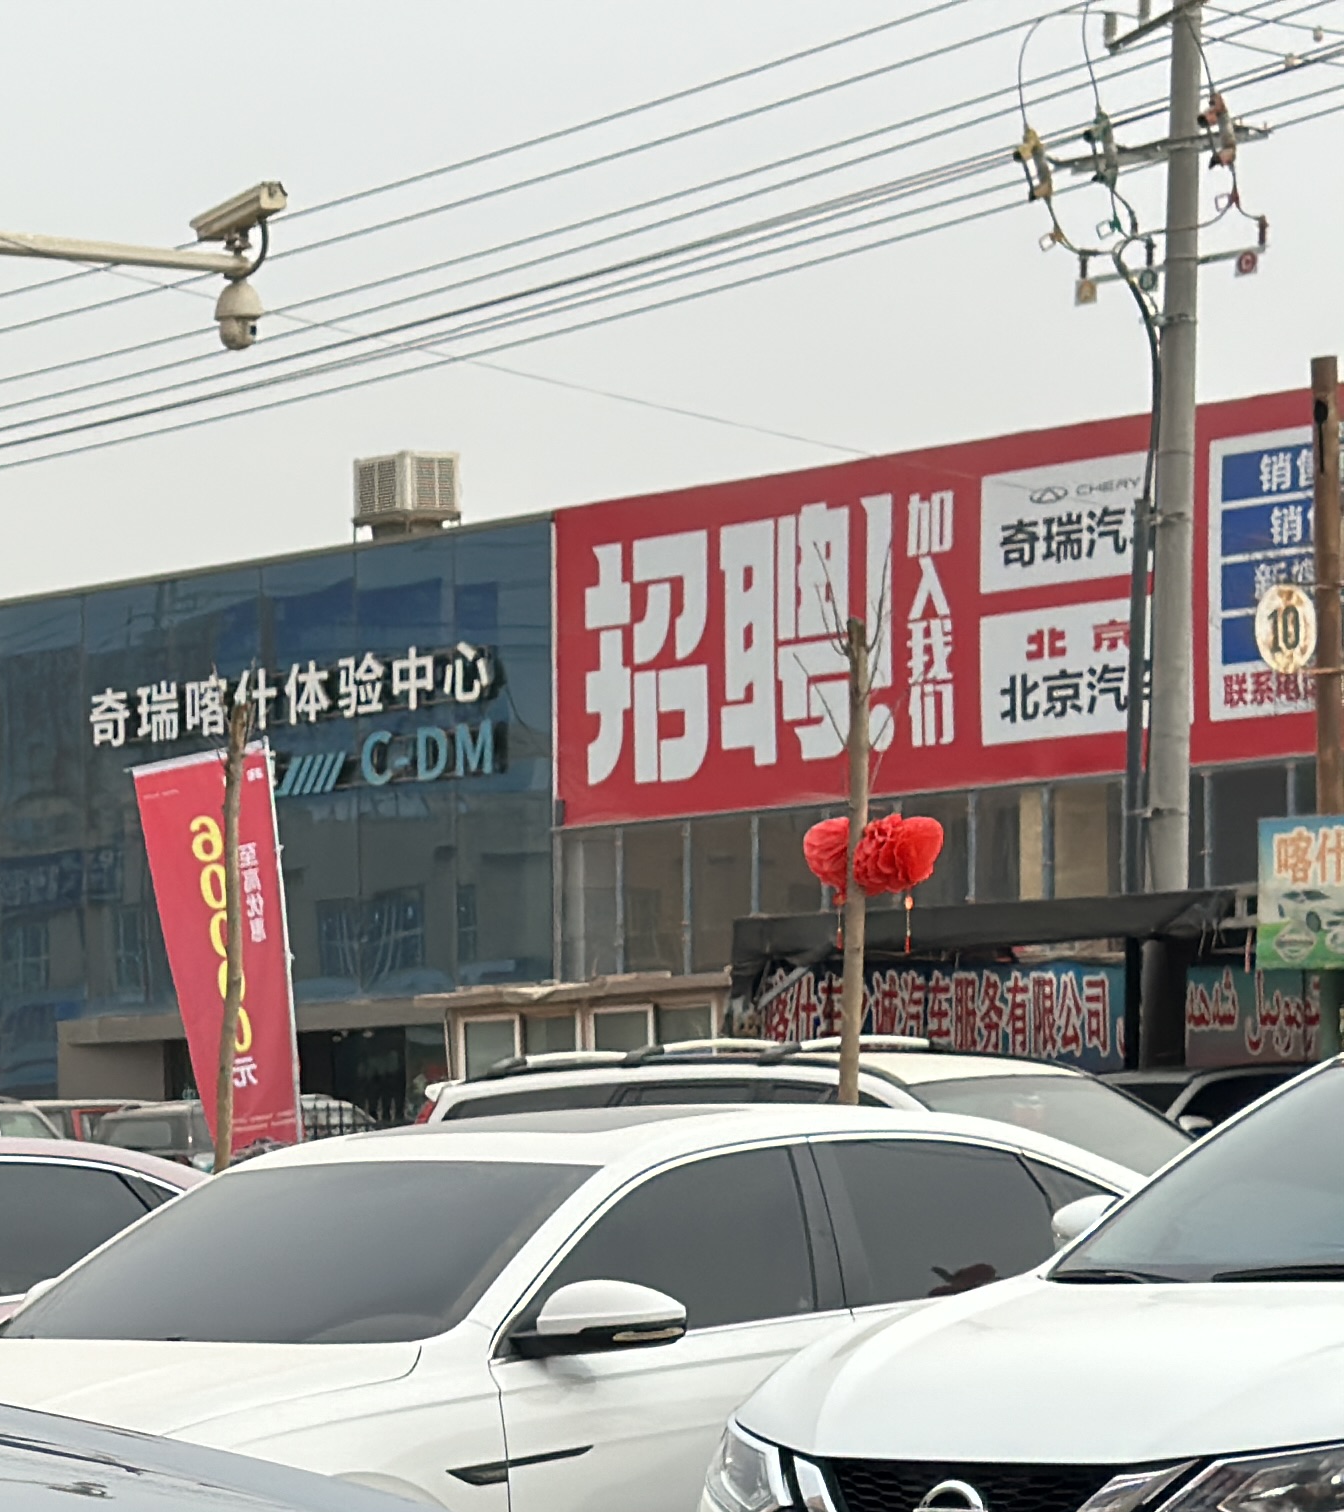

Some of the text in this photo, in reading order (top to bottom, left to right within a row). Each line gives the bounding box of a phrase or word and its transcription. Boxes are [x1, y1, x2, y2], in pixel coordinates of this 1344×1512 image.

[1076, 477, 1140, 497] CHERY
[1000, 505, 1150, 567] 奇瑞汽
[1271, 505, 1314, 546] 销
[907, 490, 955, 747] 加入我们
[1026, 619, 1130, 661] 北京
[1267, 606, 1300, 652] 10
[89, 641, 494, 748] 奇瑞喀什体验中心
[1000, 663, 1148, 723] 北京汽
[1272, 825, 1344, 886] 喀什
